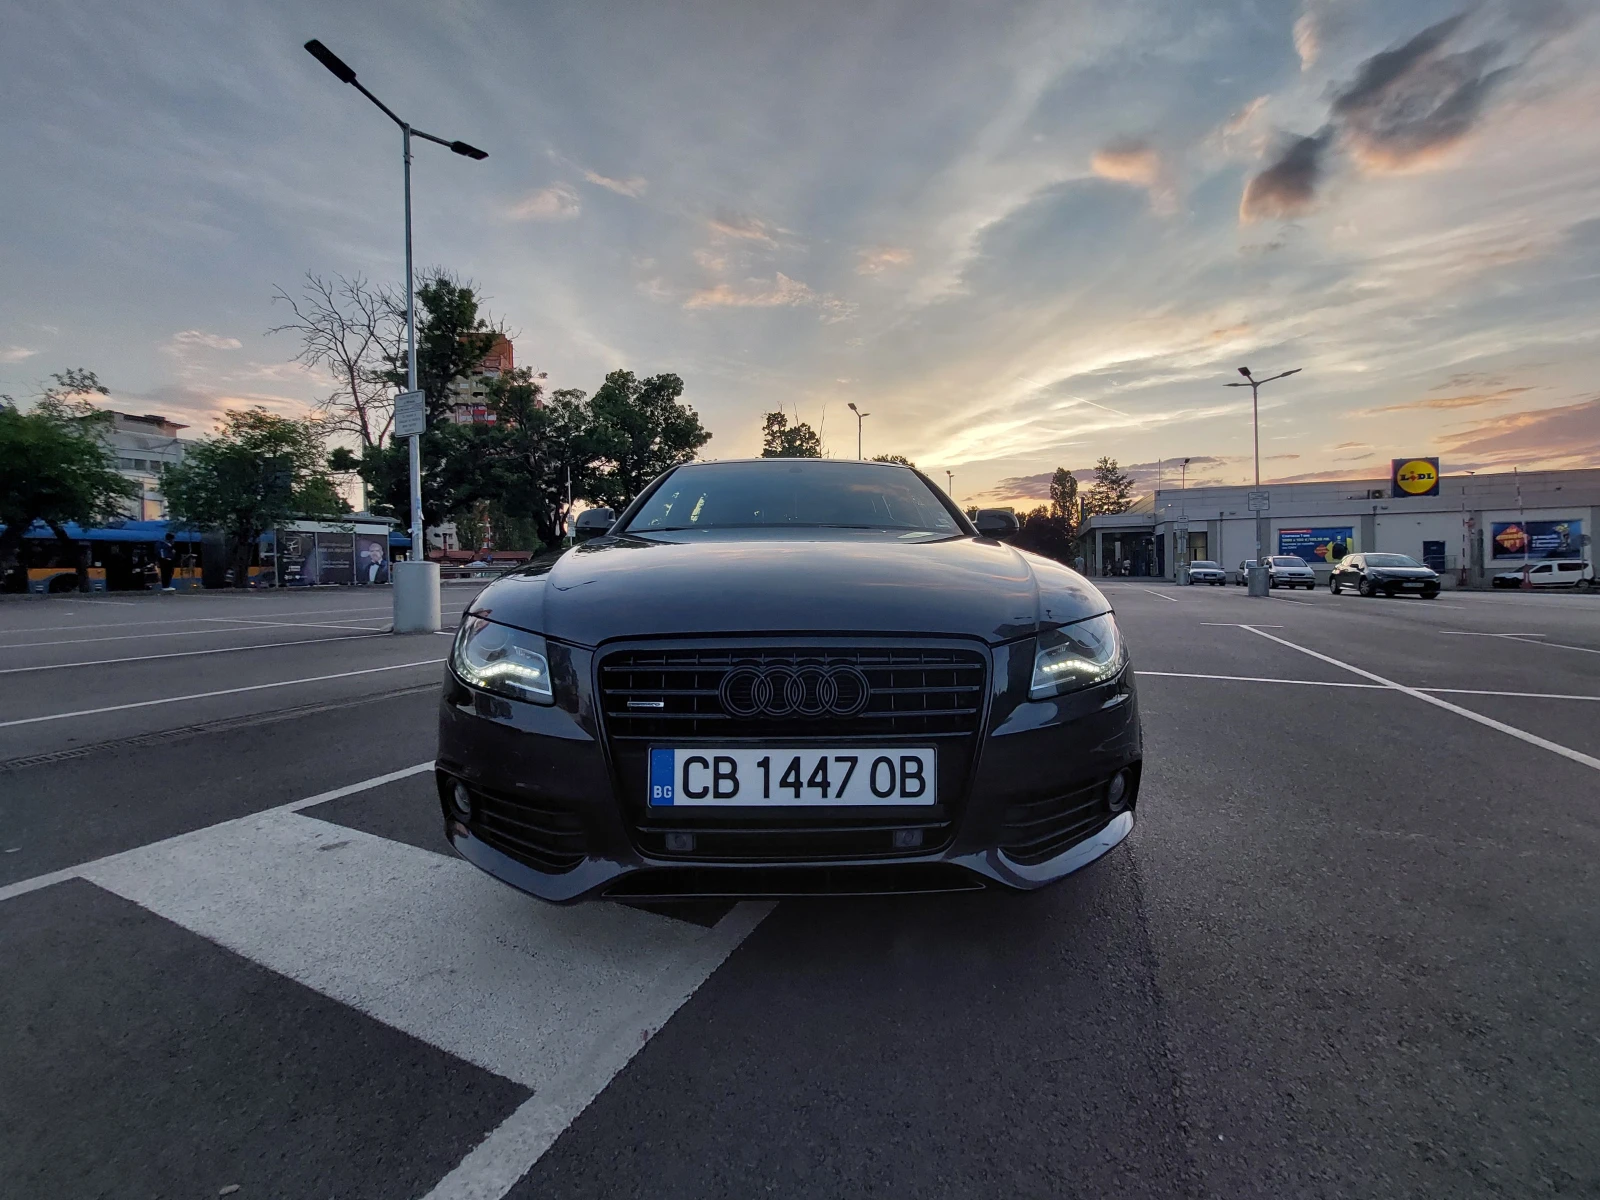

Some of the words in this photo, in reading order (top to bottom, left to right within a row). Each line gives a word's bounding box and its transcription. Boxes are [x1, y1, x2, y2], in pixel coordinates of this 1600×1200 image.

[682, 755, 740, 799] CB
[756, 755, 859, 799] 1447
[653, 785, 672, 799] BG
